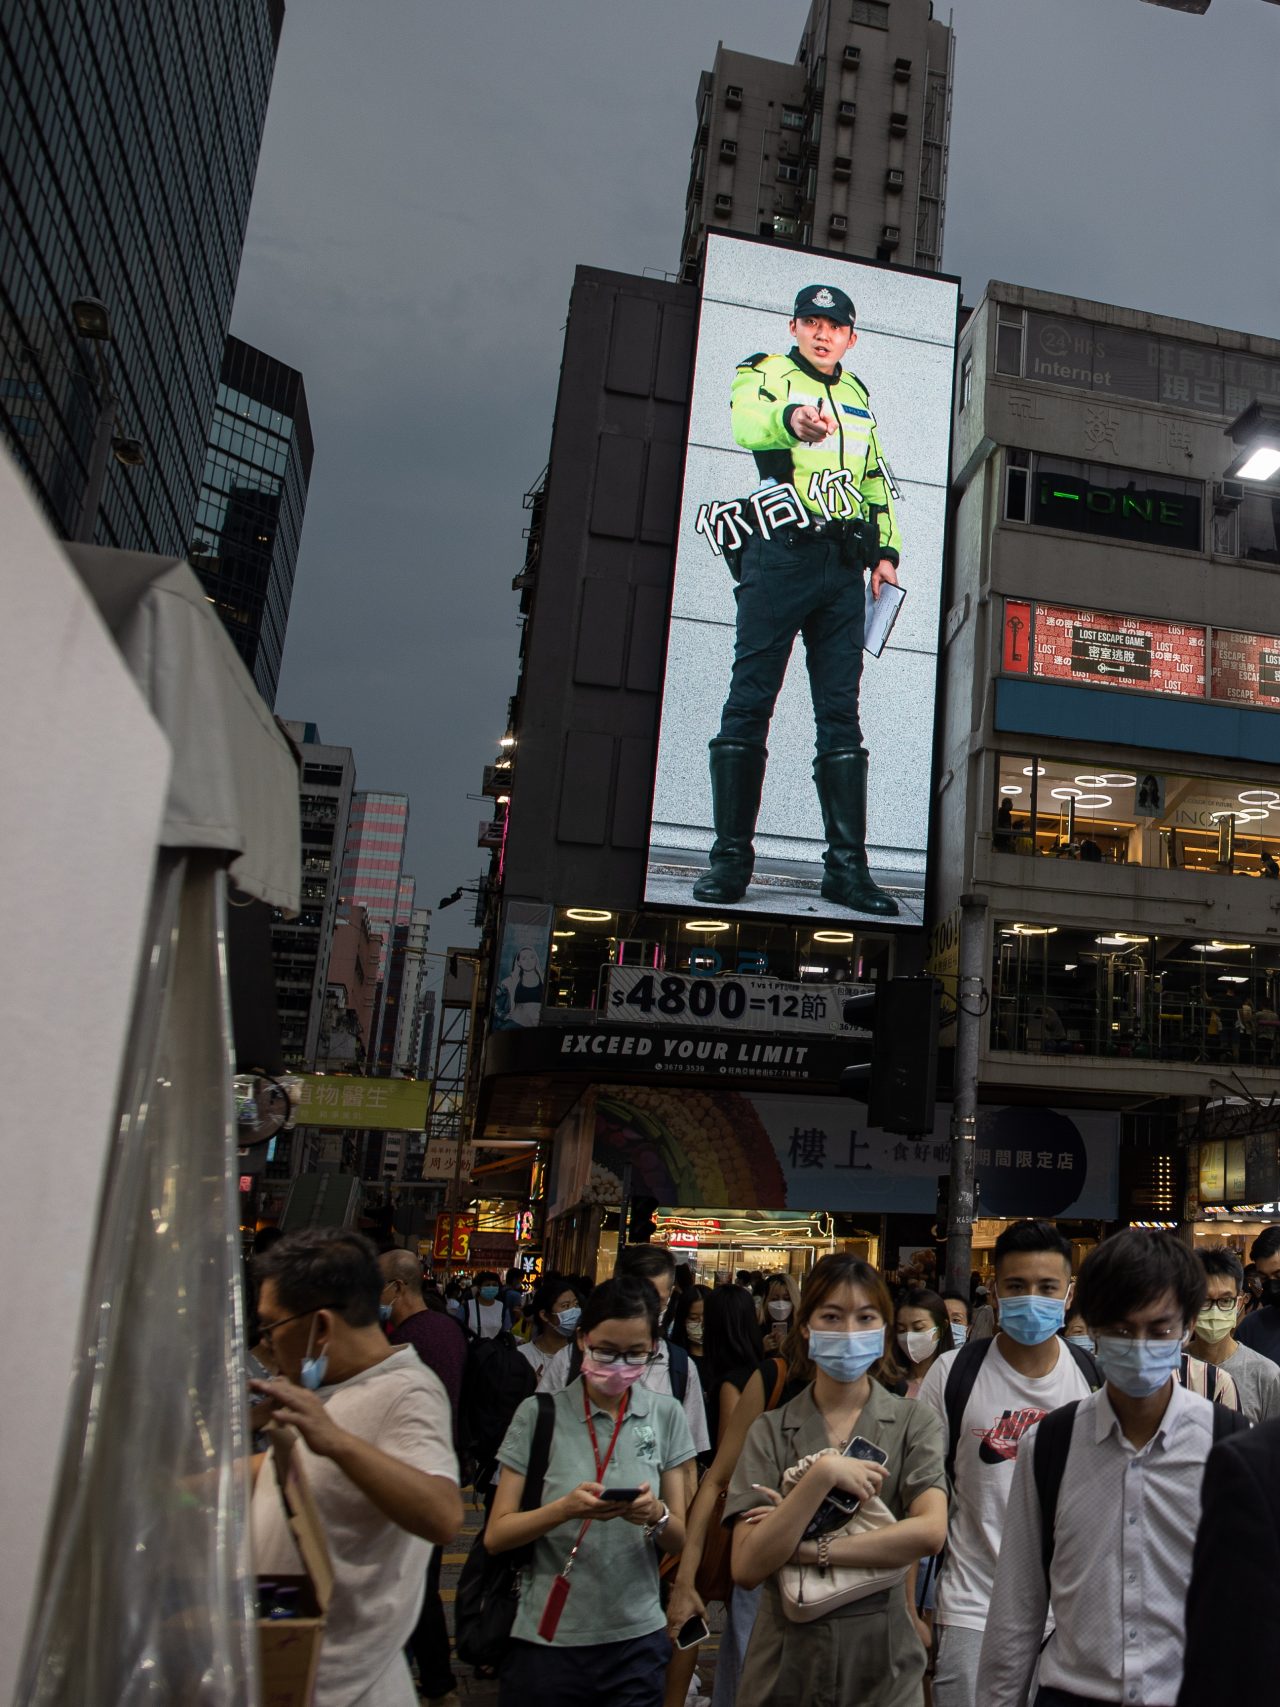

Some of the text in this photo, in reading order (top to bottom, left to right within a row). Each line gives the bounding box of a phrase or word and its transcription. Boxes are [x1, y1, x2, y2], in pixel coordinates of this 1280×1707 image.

[1046, 332, 1066, 349] 24
[1034, 357, 1112, 387] Internet
[1168, 626, 1186, 636] LOST
[1079, 629, 1145, 648] LOST ESCAPE GAME
[1230, 633, 1258, 646] ESCAPE
[1038, 643, 1057, 655] LOST
[1156, 641, 1175, 653] LOST
[1219, 649, 1247, 662] ESCAPE
[1176, 662, 1194, 674] LOST
[1164, 679, 1182, 691] LOST
[1227, 688, 1255, 700] ESCAPE
[1175, 810, 1232, 828] INOA
[560, 1034, 809, 1066] EXCEED YOUR LIMIT
[789, 1126, 873, 1170] 樓上
